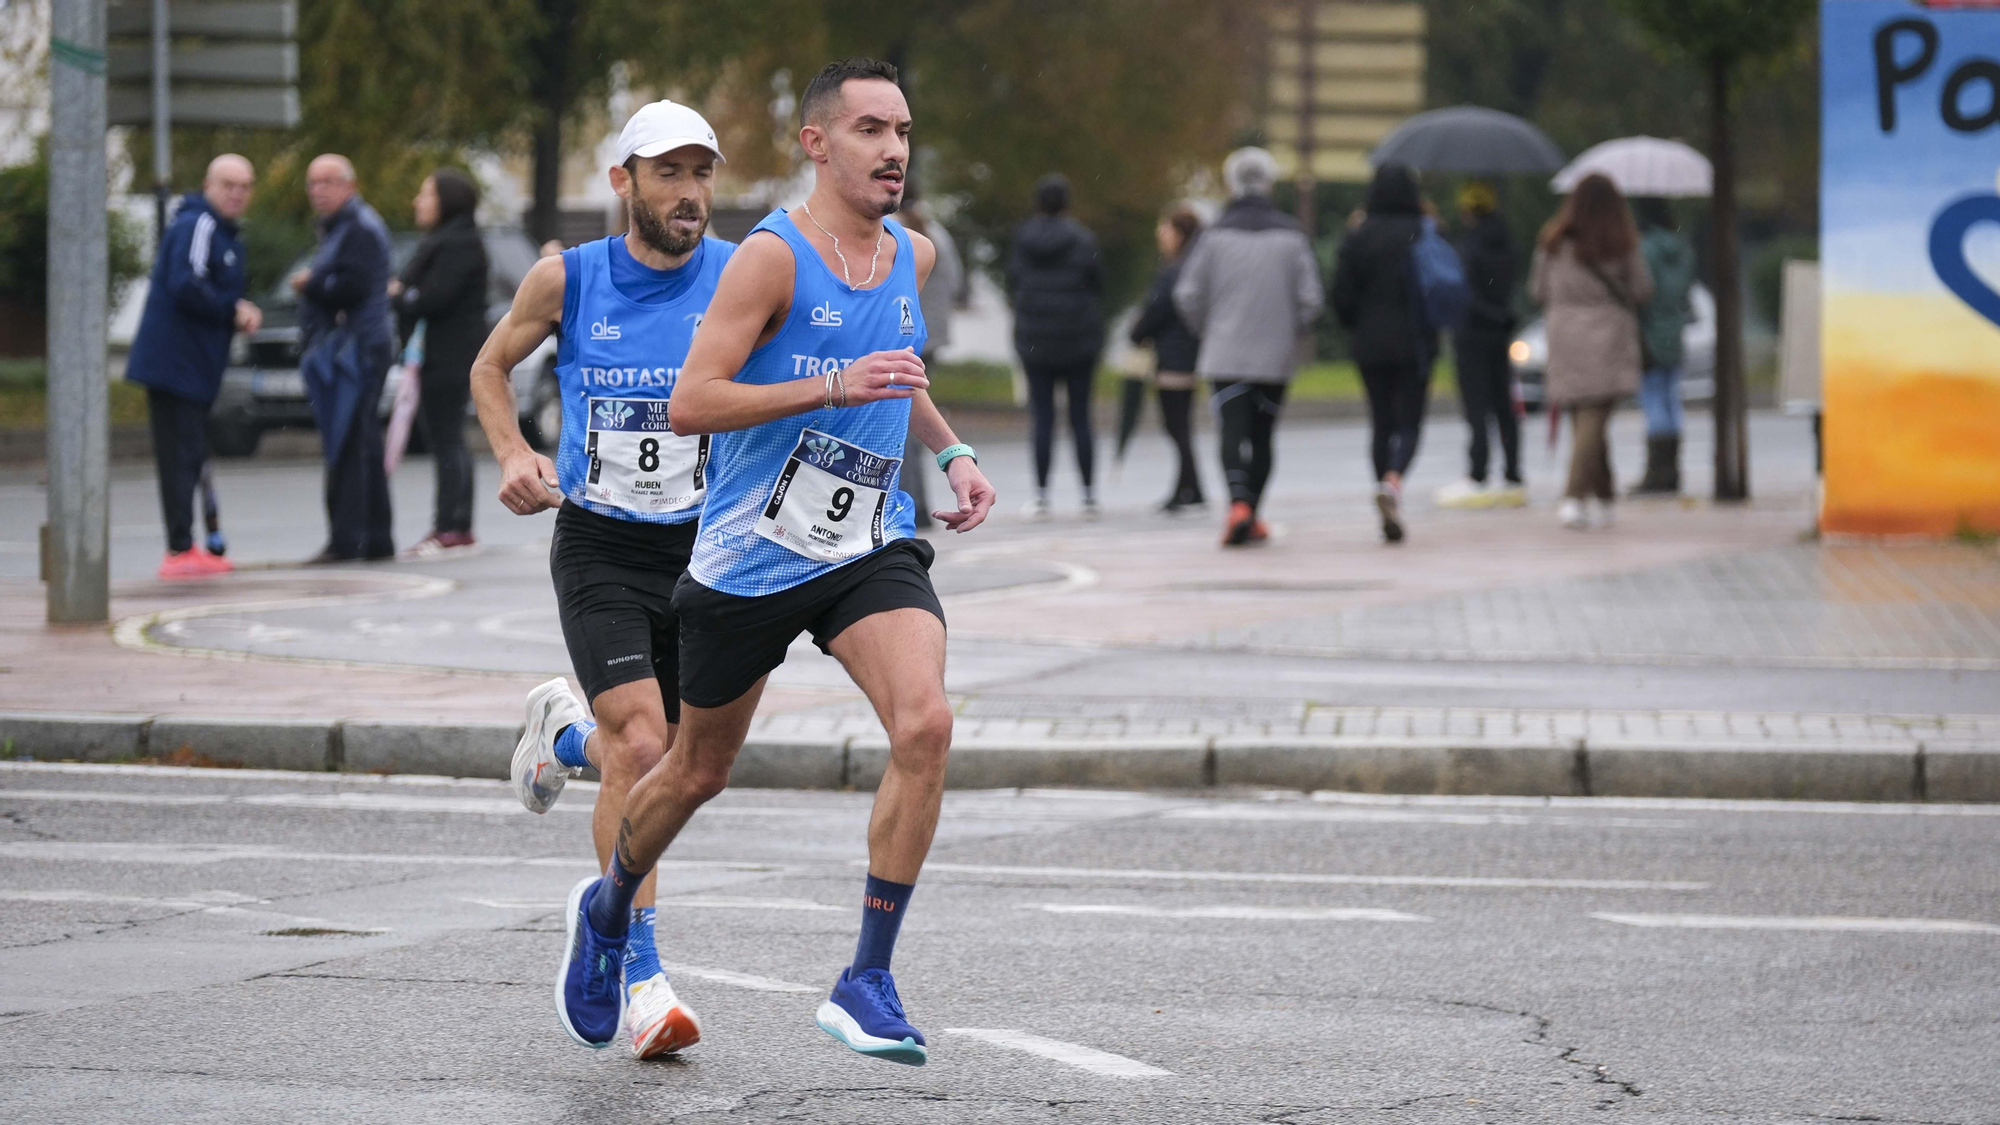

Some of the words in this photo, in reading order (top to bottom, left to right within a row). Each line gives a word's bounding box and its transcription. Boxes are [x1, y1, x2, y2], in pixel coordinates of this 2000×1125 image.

[809, 300, 843, 327] als
[590, 316, 622, 340] als
[646, 402, 670, 414] ME
[602, 411, 626, 429] 39
[638, 437, 660, 473] 8
[634, 480, 662, 489] RUBEN
[826, 486, 855, 522] 9
[810, 524, 843, 542] ANTONIO
